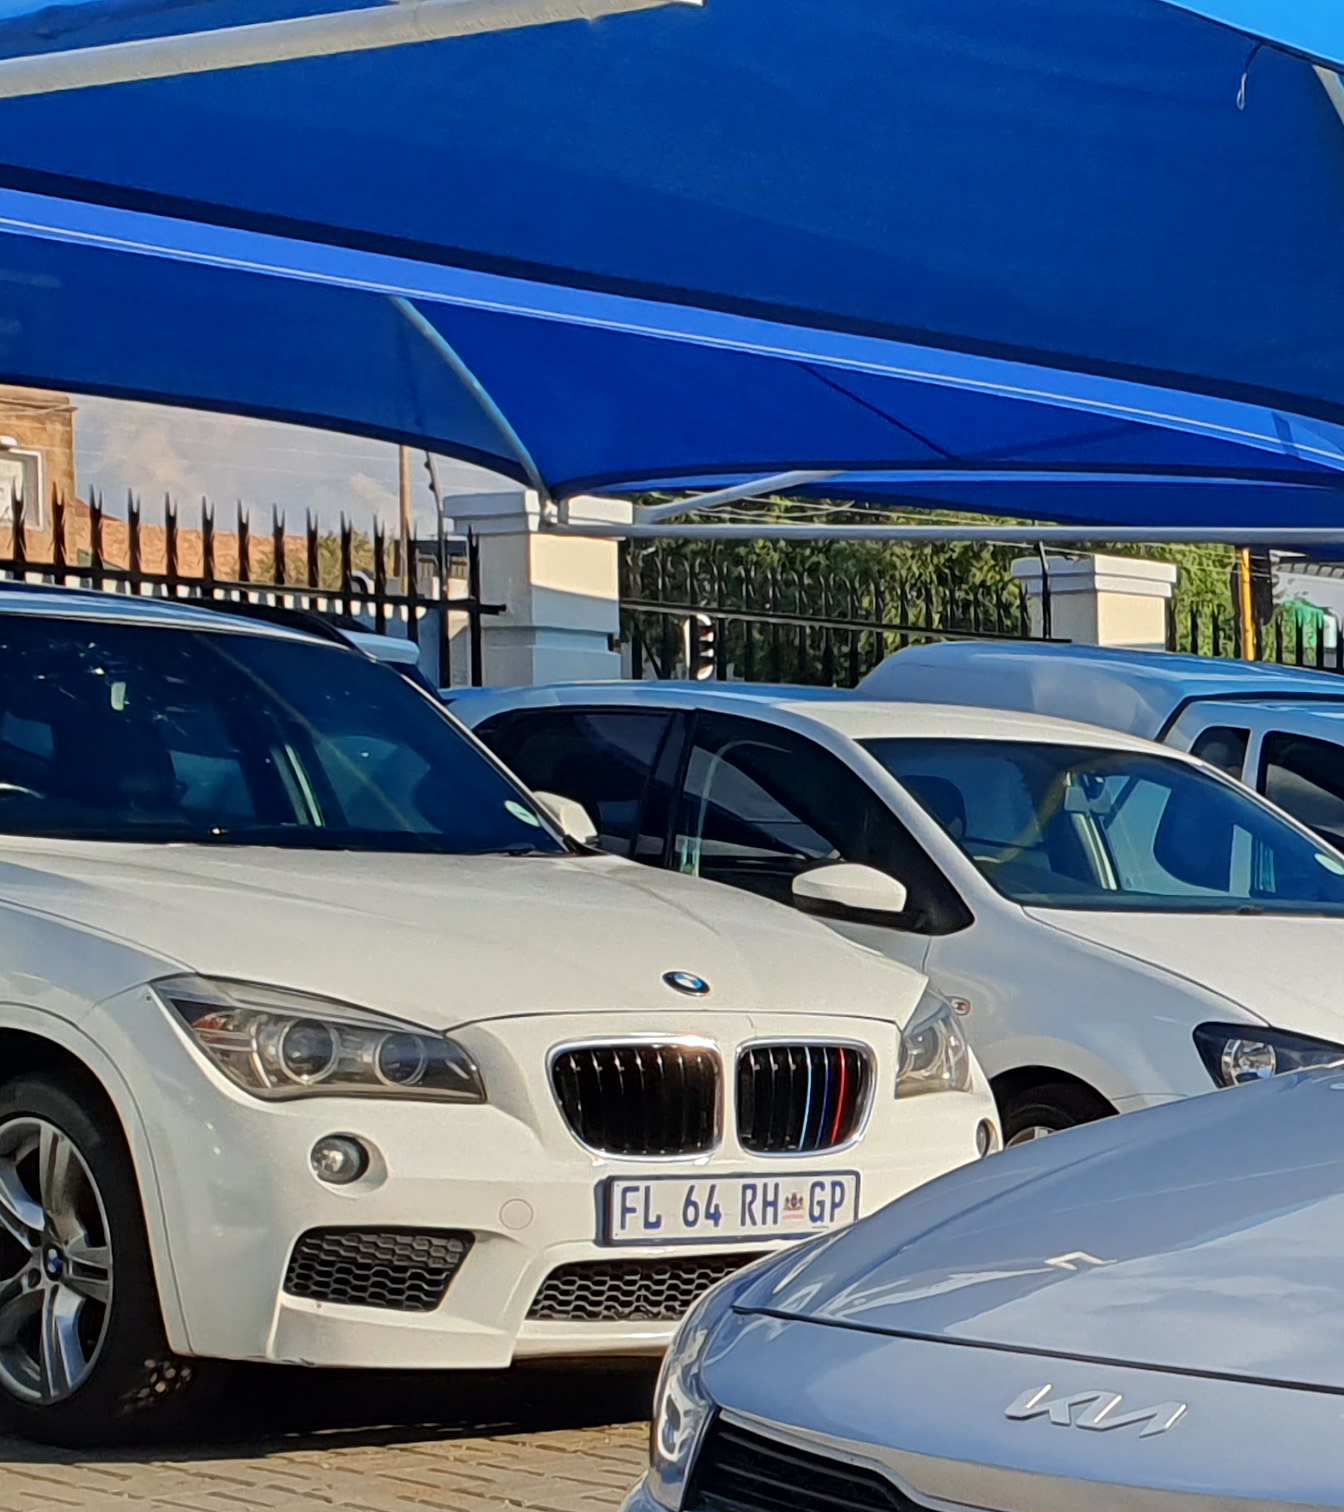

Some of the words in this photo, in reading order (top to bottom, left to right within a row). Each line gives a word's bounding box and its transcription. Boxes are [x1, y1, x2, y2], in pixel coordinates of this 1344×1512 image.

[618, 1185, 662, 1230] FL
[682, 1183, 722, 1228] 64
[740, 1181, 781, 1227] RH
[808, 1179, 845, 1223] GP
